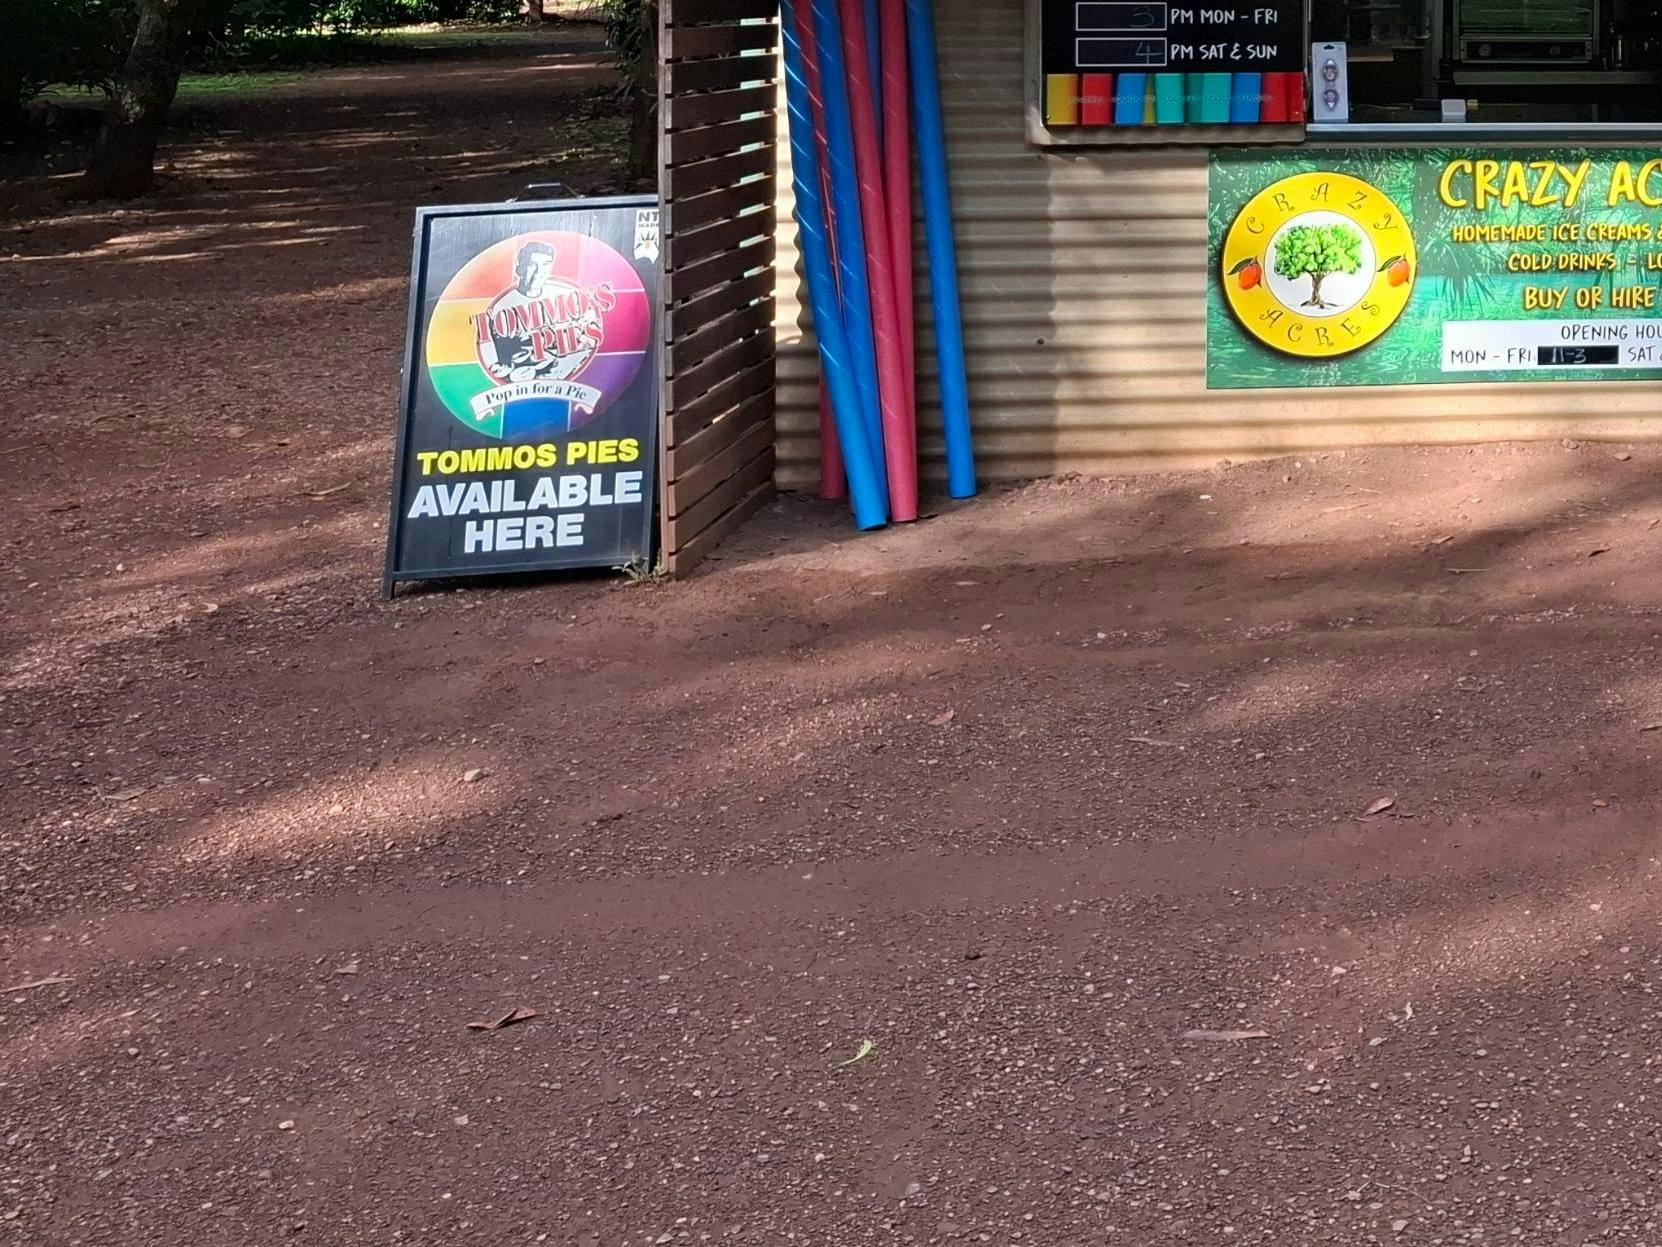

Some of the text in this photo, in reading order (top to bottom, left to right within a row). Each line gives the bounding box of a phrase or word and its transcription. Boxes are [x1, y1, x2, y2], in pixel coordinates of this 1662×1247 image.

[1170, 8, 1194, 24] PM
[1200, 9, 1235, 25] MON
[1254, 8, 1278, 24] FRI
[1136, 41, 1278, 64] 4 PM SAT & SUN
[1439, 158, 1591, 210] CRAZY
[638, 212, 660, 222] NT
[1246, 182, 1398, 234] CRAZY
[1453, 224, 1546, 243] HOMEMADE
[1553, 224, 1580, 241] ICE
[1586, 222, 1652, 241] CREAMS
[1508, 253, 1552, 272] COLD
[1558, 253, 1617, 272] DRINKS
[1524, 286, 1568, 310] BUY
[1576, 286, 1602, 310] OR
[1611, 286, 1657, 308] HIRE
[1259, 300, 1380, 347] ACRES
[1560, 324, 1628, 340] OPENING
[529, 321, 605, 363] PIES
[1450, 348, 1486, 365] MON
[1551, 347, 1587, 364] 11-3
[1628, 347, 1656, 363] SAT
[485, 381, 587, 405] Pop in for a Pie
[417, 438, 639, 475] TOMMOS PIES
[407, 470, 643, 519] AVAILABLE
[464, 513, 585, 553] HERE
